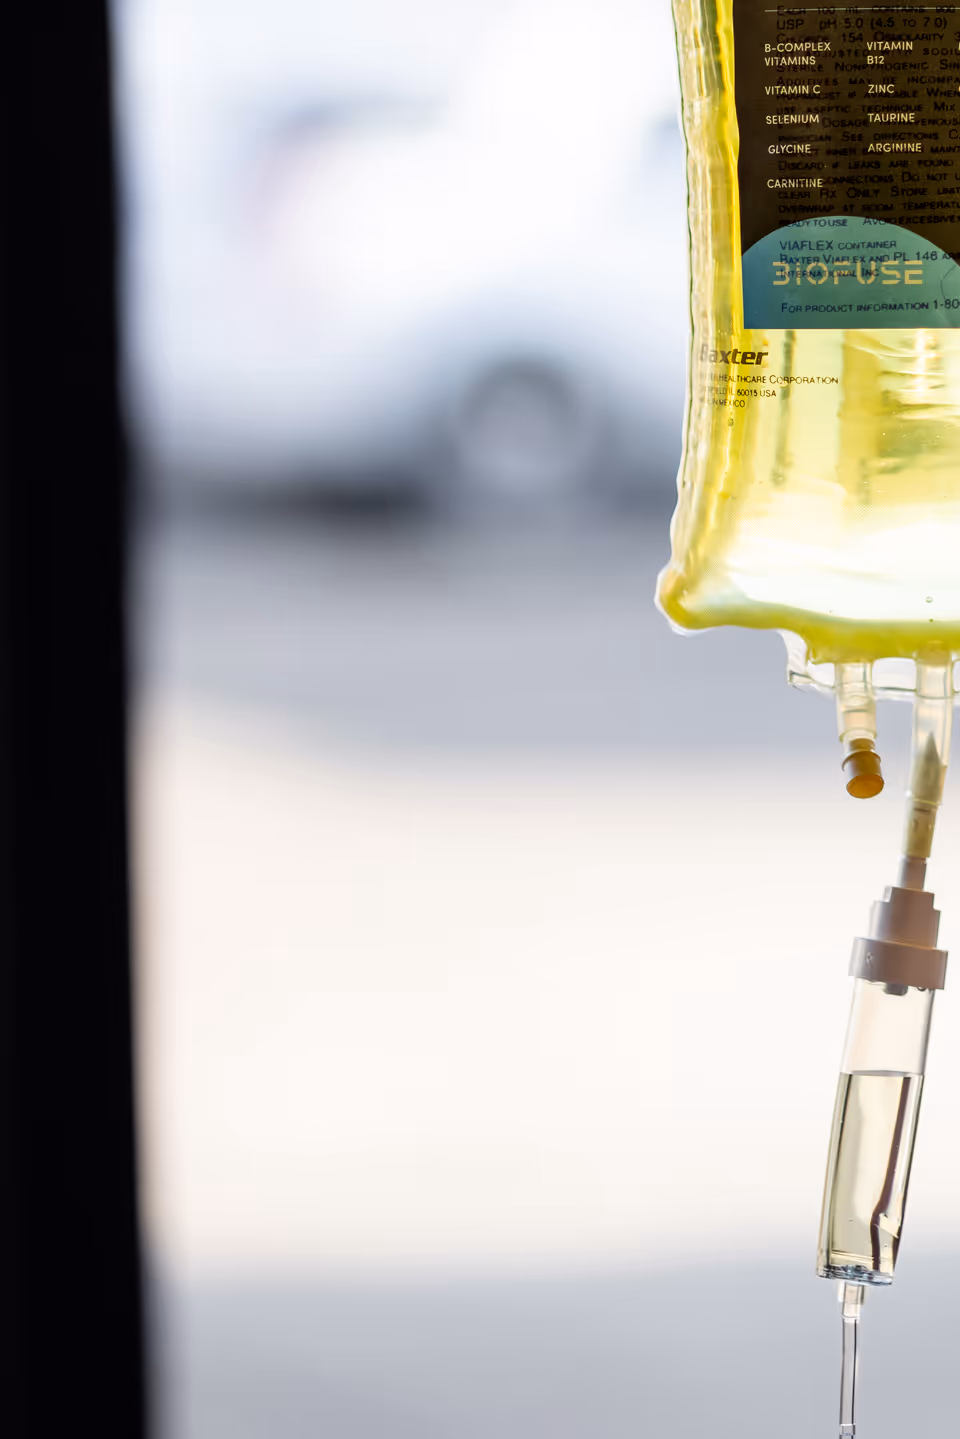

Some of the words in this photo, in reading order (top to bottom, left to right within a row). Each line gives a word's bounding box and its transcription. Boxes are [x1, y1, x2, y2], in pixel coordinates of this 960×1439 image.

[776, 18, 805, 31] USP
[764, 41, 832, 53] B-COMPLEX
[866, 41, 913, 52] VITAMIN
[764, 55, 816, 67] VITAMINS
[866, 55, 885, 65] B12
[765, 85, 809, 96] VITAMIN
[812, 84, 821, 94] C
[867, 84, 895, 94] ZINC
[766, 114, 820, 125] SELENIUM
[867, 113, 916, 123] TAURINE
[768, 143, 812, 155] GLYCINE
[867, 142, 922, 153] ARGININE
[767, 178, 824, 189] CARNITINE
[779, 240, 834, 251] VIAFLEX
[838, 240, 897, 250] CONTAINER
[893, 251, 910, 262] PL
[915, 251, 938, 261] 146
[781, 302, 804, 314] FOR
[805, 303, 852, 313] PRODUCT
[856, 301, 929, 312] INFORMATION
[769, 374, 839, 385] CORPORATION
